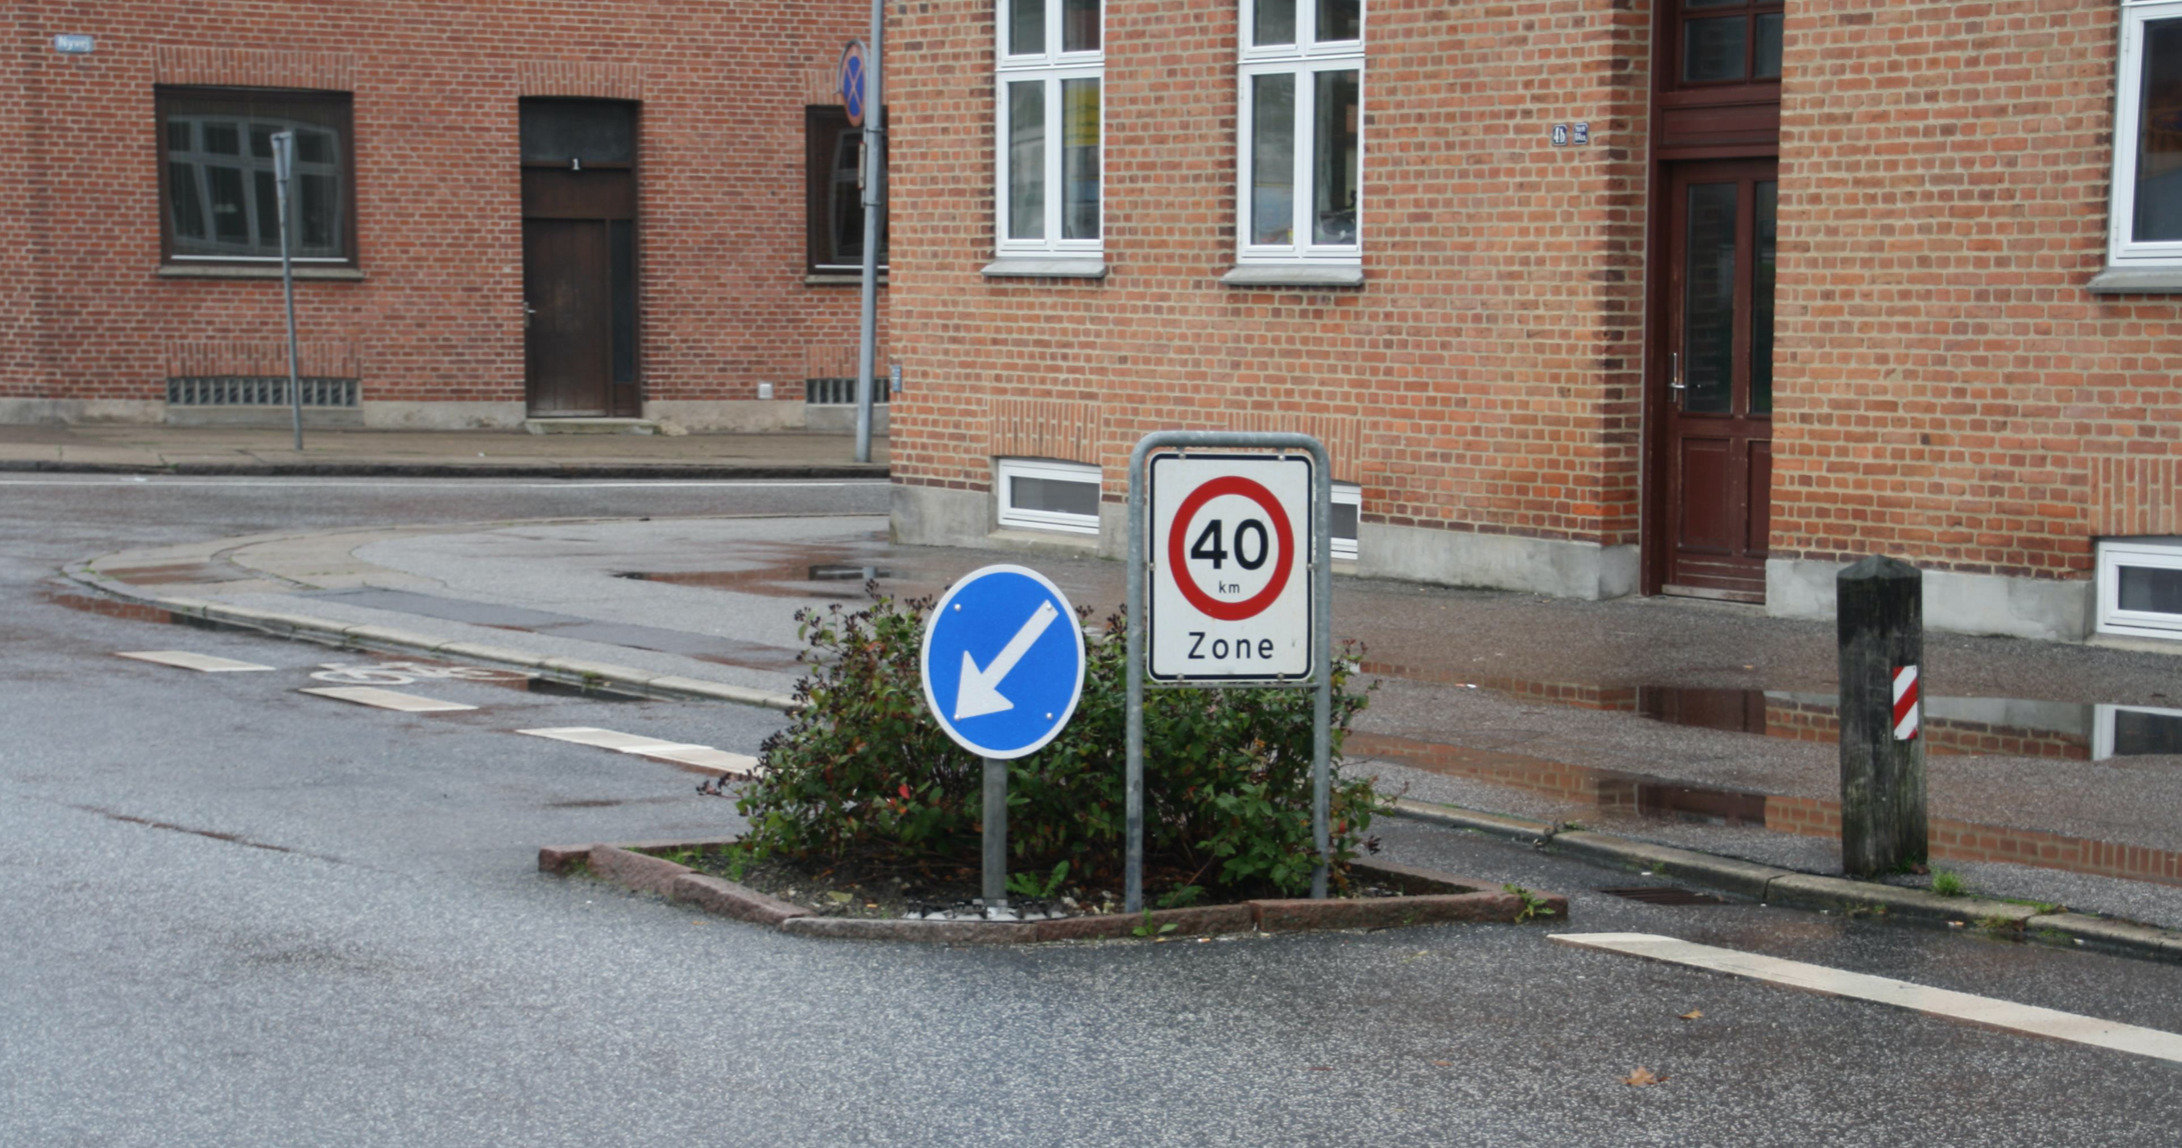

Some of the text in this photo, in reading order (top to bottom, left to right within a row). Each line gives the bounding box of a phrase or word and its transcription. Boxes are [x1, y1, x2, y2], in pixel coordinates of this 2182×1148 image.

[572, 158, 580, 170] 1
[1190, 518, 1269, 570] 40
[1219, 581, 1240, 594] km
[1187, 631, 1274, 660] Zone
